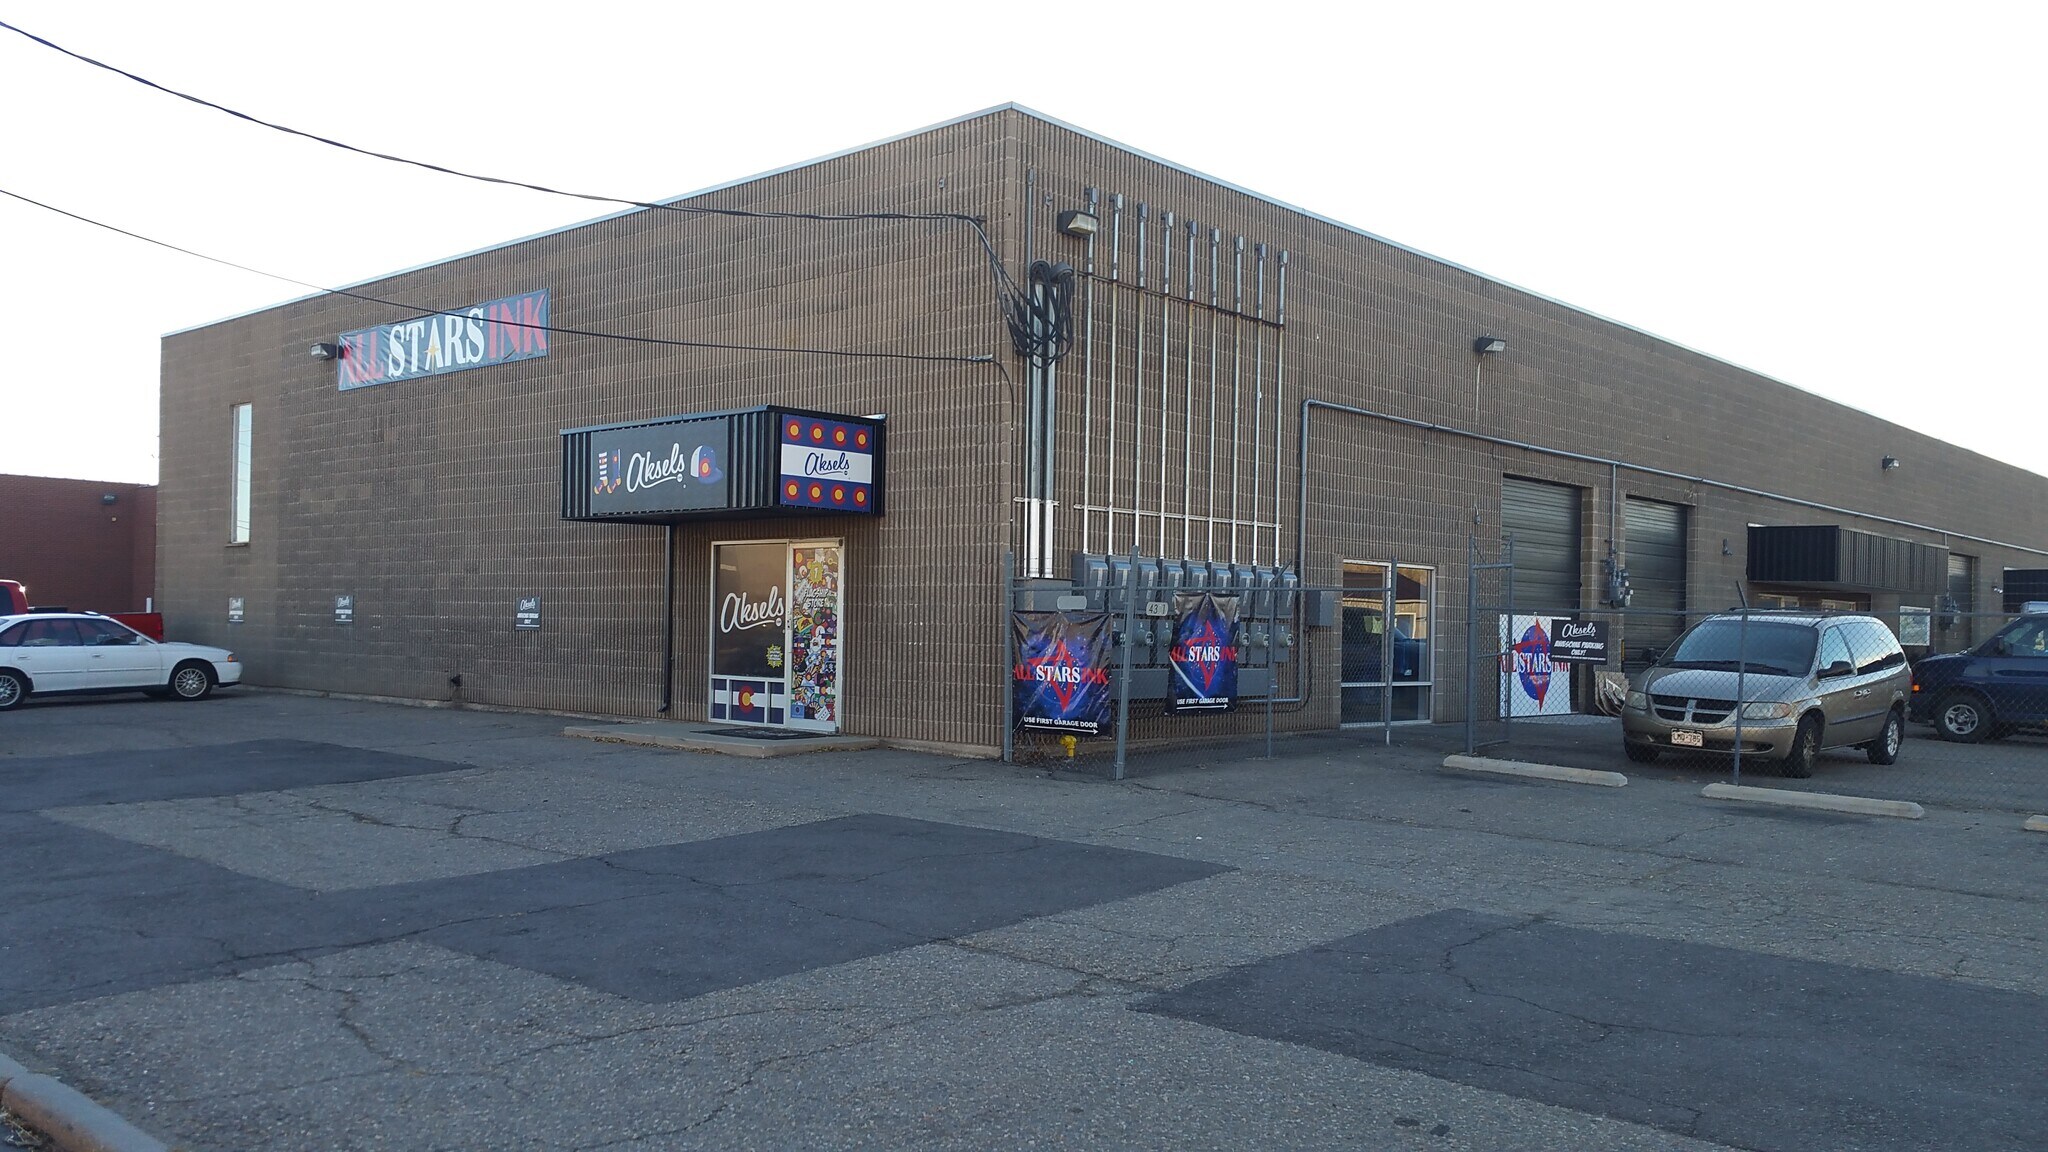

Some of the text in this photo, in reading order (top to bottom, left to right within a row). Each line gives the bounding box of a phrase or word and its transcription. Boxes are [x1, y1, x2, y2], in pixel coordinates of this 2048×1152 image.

[340, 294, 547, 385] ALL STARS INK
[626, 442, 686, 494] Aksels
[805, 452, 851, 476] Aksels
[720, 585, 784, 634] Aksels
[1561, 622, 1597, 638] Aksels
[1188, 646, 1220, 662] STARS
[1518, 651, 1552, 673] STARS
[1014, 664, 1110, 685] ALL STARS INK
[1036, 717, 1053, 725] FIRST
[1053, 718, 1079, 727] GARAGE
[1080, 721, 1098, 729] DOOR
